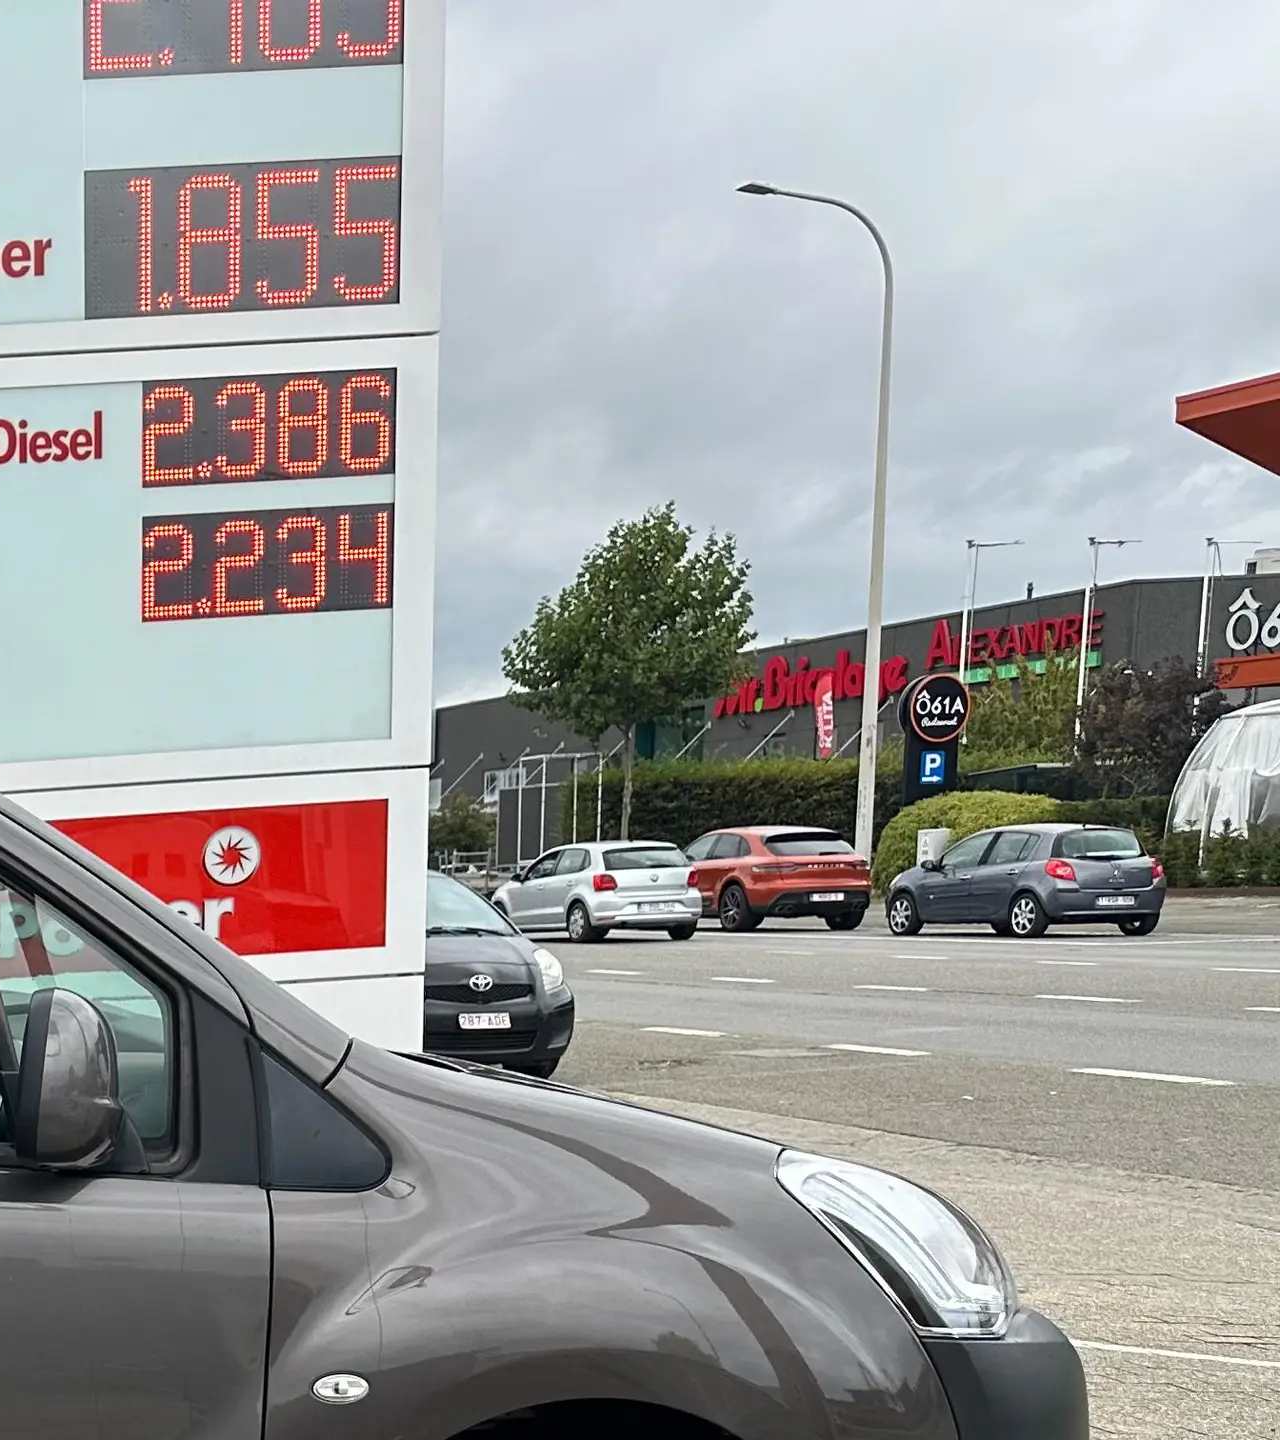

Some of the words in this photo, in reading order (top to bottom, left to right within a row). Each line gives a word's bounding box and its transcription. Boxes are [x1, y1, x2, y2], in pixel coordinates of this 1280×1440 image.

[128, 164, 398, 312] 1.855
[142, 373, 391, 483] 2.386
[142, 511, 389, 620] 2.234
[915, 689, 965, 715] Ô61A
[924, 753, 942, 776] P
